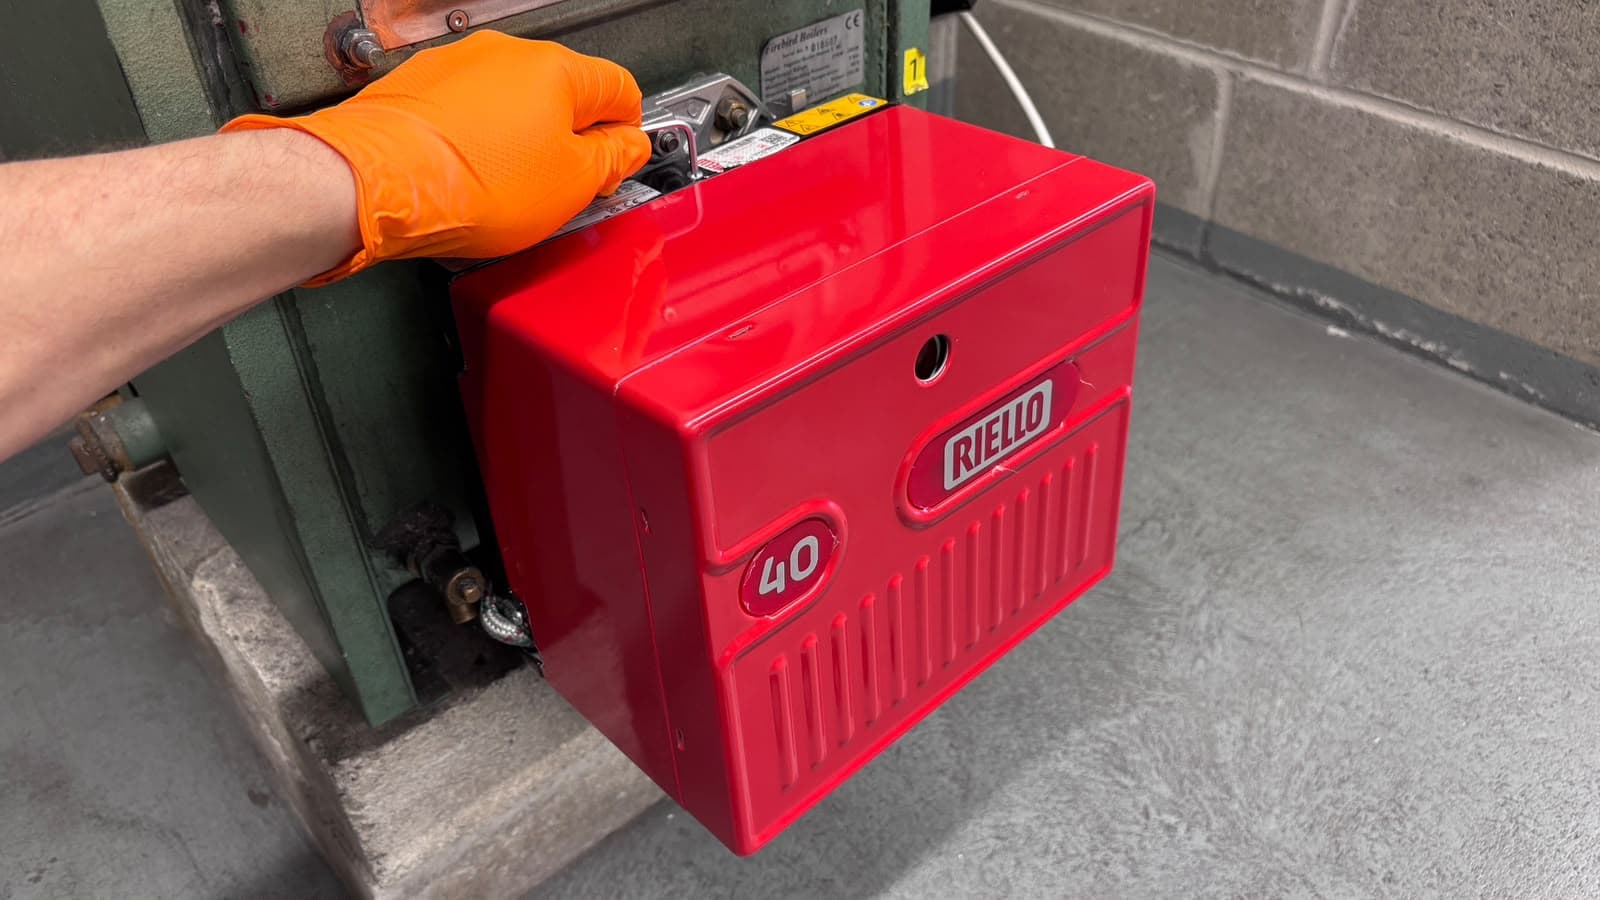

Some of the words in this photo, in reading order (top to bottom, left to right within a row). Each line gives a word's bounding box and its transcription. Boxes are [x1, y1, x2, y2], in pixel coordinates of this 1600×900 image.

[799, 26, 828, 42] Boilers
[909, 58, 918, 82] 1
[952, 390, 1045, 481] RIELLO
[758, 535, 819, 595] 40
